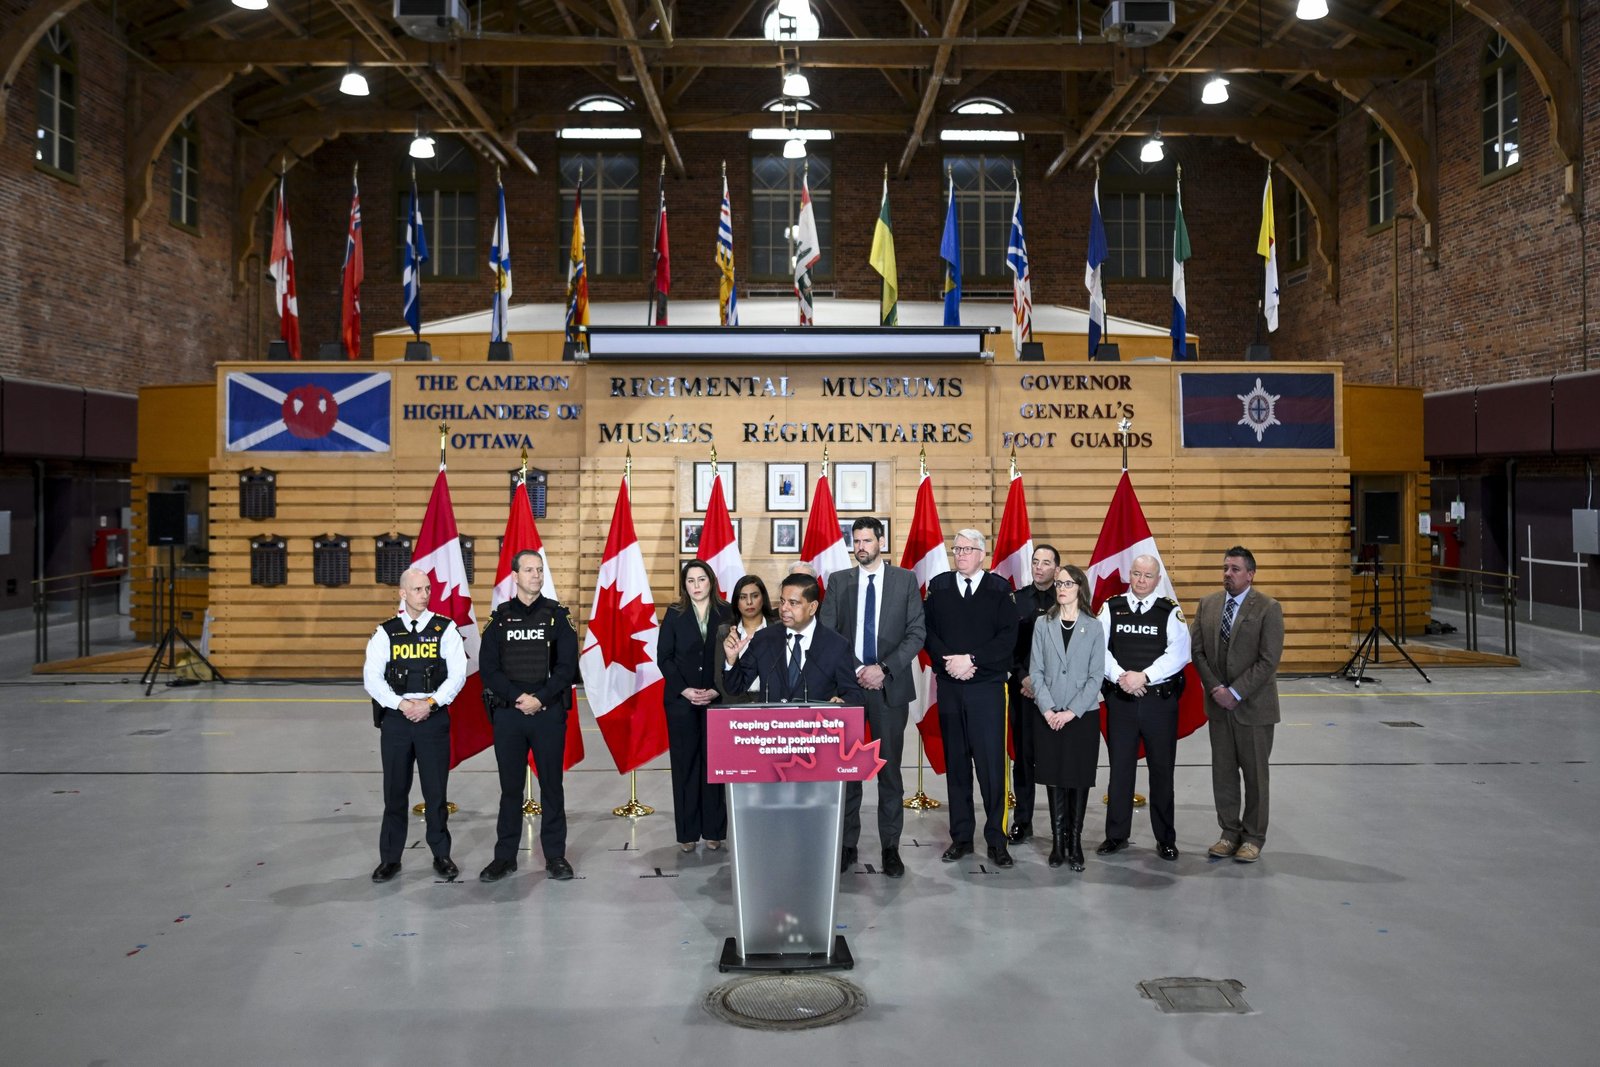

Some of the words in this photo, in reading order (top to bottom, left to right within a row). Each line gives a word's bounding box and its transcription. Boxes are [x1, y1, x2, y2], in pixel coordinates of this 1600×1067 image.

[416, 375, 458, 391] THE
[466, 375, 569, 391] CAMERON
[610, 376, 795, 397] REGIMENTAL
[821, 376, 963, 397] MUSEUMS
[1020, 374, 1132, 391] GOVERNOR
[403, 404, 550, 420] HIGHLANDERS
[557, 404, 582, 420] OF
[1020, 401, 1134, 420] GENERAL'S
[598, 414, 713, 443] MUSÉES
[742, 414, 973, 443] RÉGIMENTAIRES
[451, 433, 533, 449] OTTAWA
[1002, 432, 1057, 448] FOOT
[1070, 432, 1153, 448] GUARDS
[507, 629, 544, 641] POLICE
[1116, 624, 1158, 635] POLICE
[392, 642, 437, 660] POLICE
[729, 720, 769, 731] Keeping
[770, 719, 821, 729] Canadians
[822, 718, 844, 728] Safe
[734, 735, 776, 746] Protéger
[778, 735, 787, 744] la
[788, 734, 840, 745] population
[759, 745, 816, 754] canadienne
